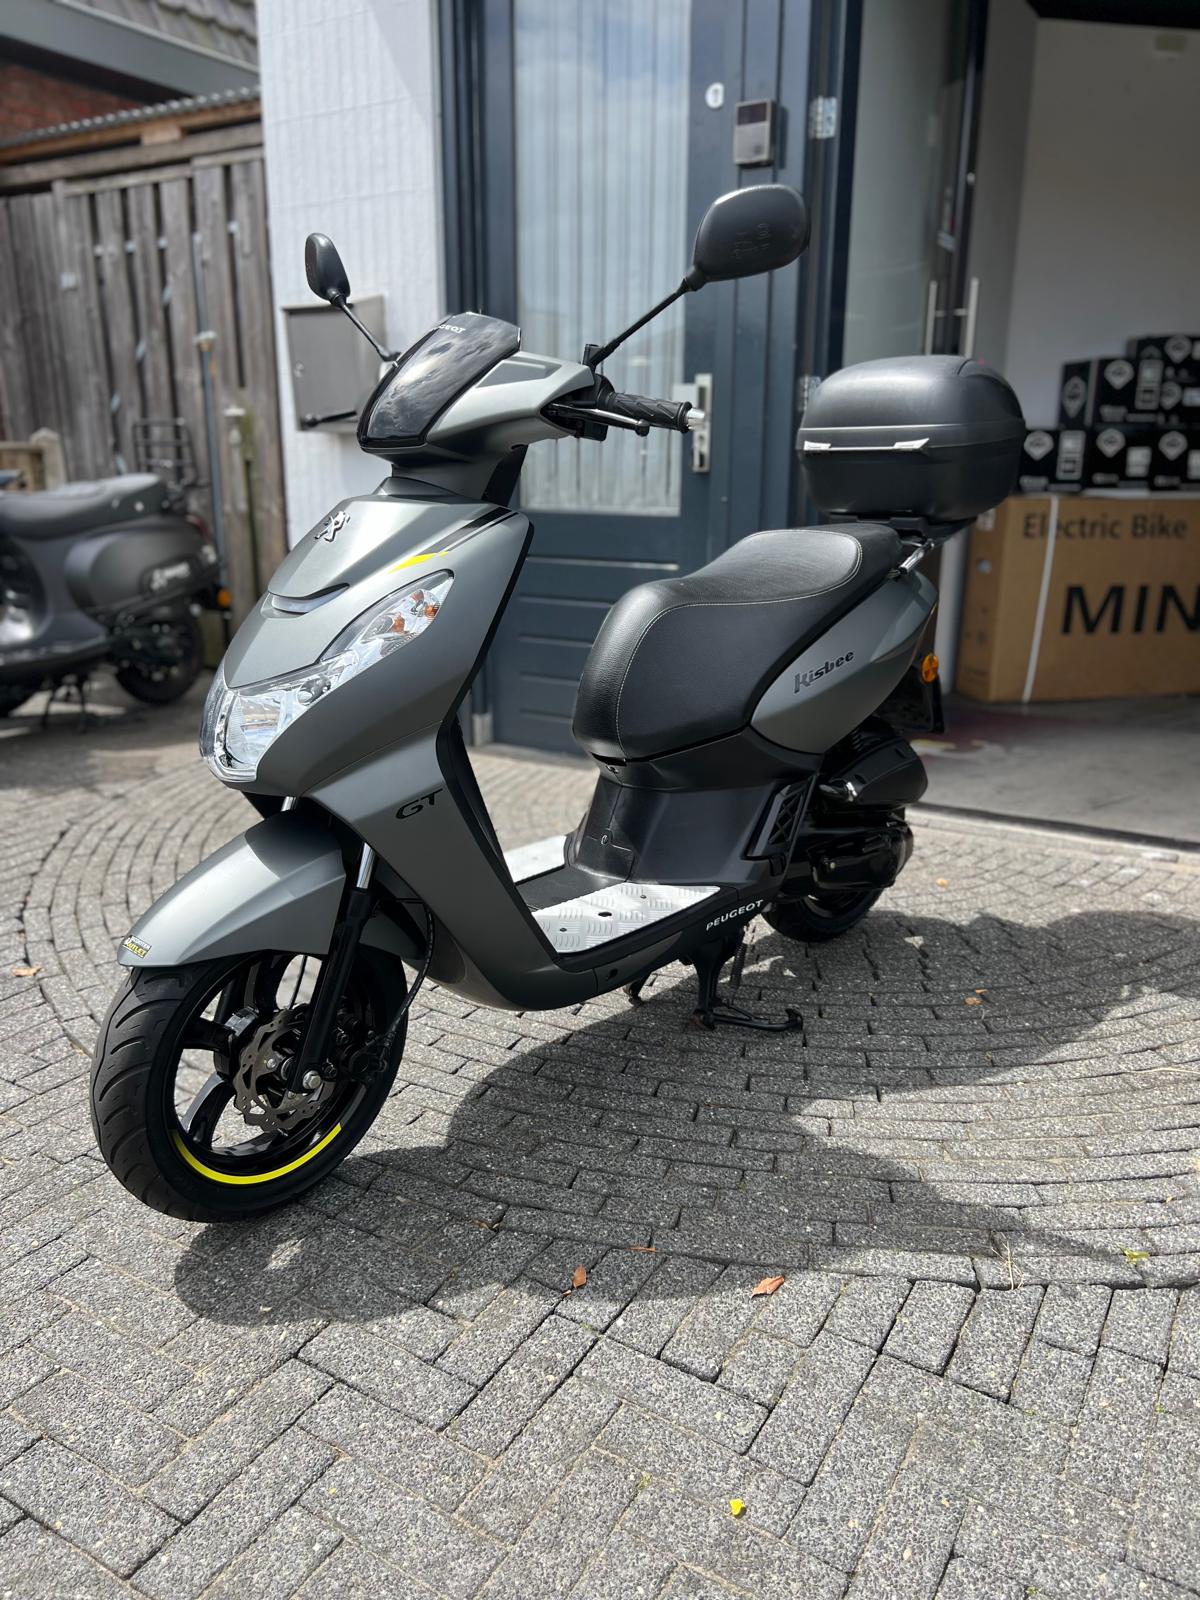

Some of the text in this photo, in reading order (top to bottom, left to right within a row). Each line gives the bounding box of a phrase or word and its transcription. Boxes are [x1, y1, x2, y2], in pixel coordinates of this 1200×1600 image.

[1131, 512, 1187, 539] Bike
[794, 651, 854, 694] Kisbee
[395, 788, 443, 819] GT
[706, 899, 763, 931] PEUGEOT
